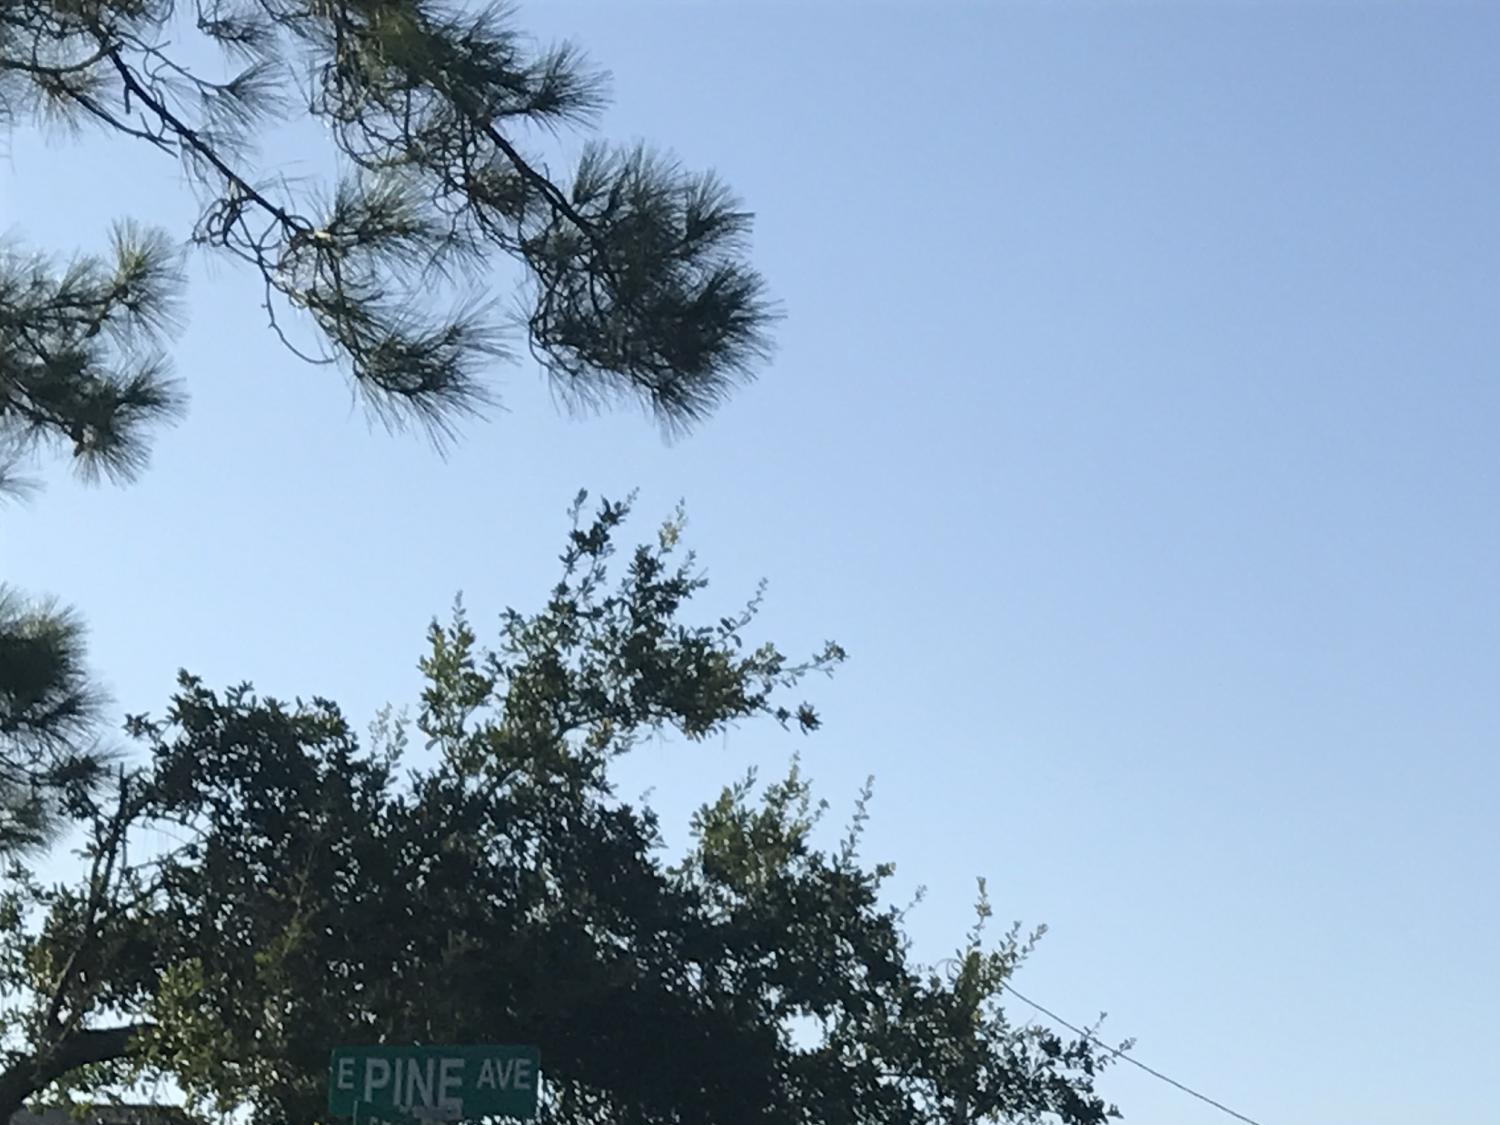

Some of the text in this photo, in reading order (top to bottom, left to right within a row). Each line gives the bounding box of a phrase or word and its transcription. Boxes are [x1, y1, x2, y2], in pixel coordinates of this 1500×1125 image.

[337, 1057, 532, 1109] E PINE AVE
